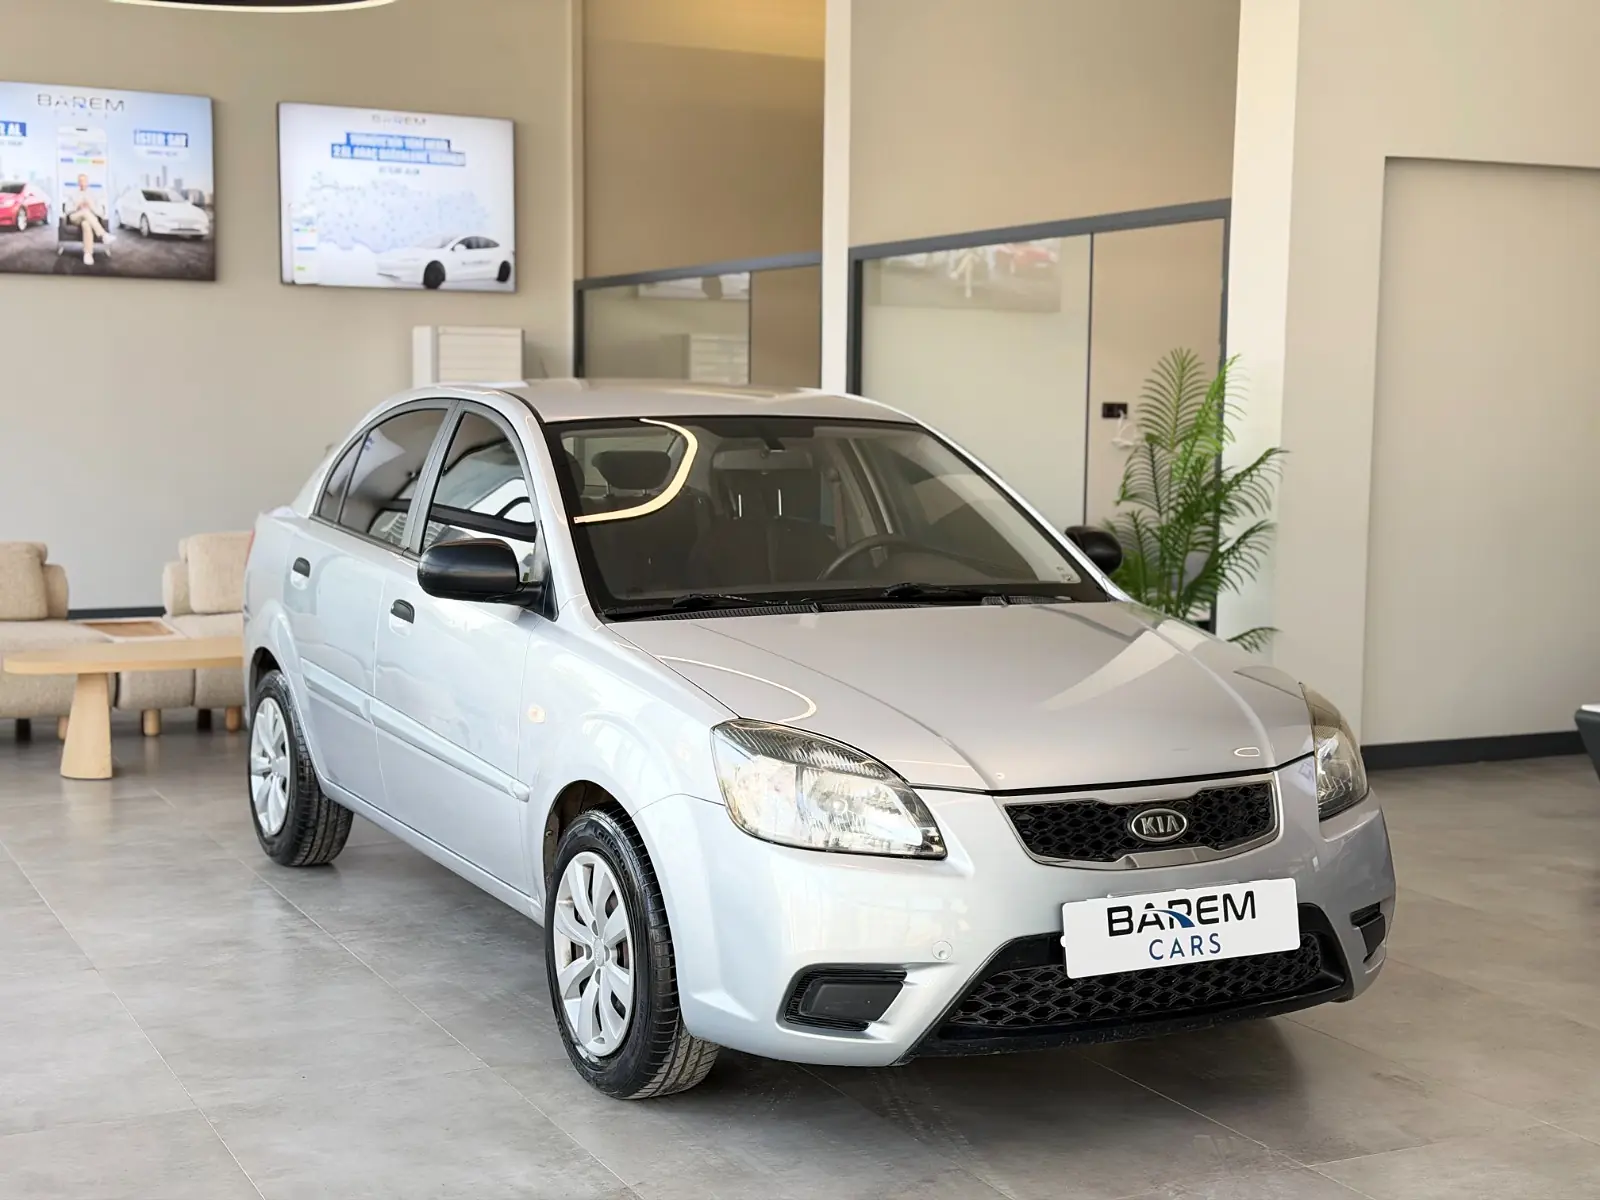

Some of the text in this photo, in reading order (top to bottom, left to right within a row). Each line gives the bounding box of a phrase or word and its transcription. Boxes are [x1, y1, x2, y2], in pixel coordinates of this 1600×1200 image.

[37, 93, 125, 112] BAREM
[1140, 814, 1181, 835] KIA
[1106, 890, 1257, 937] BAREM
[1148, 932, 1222, 961] CARS
